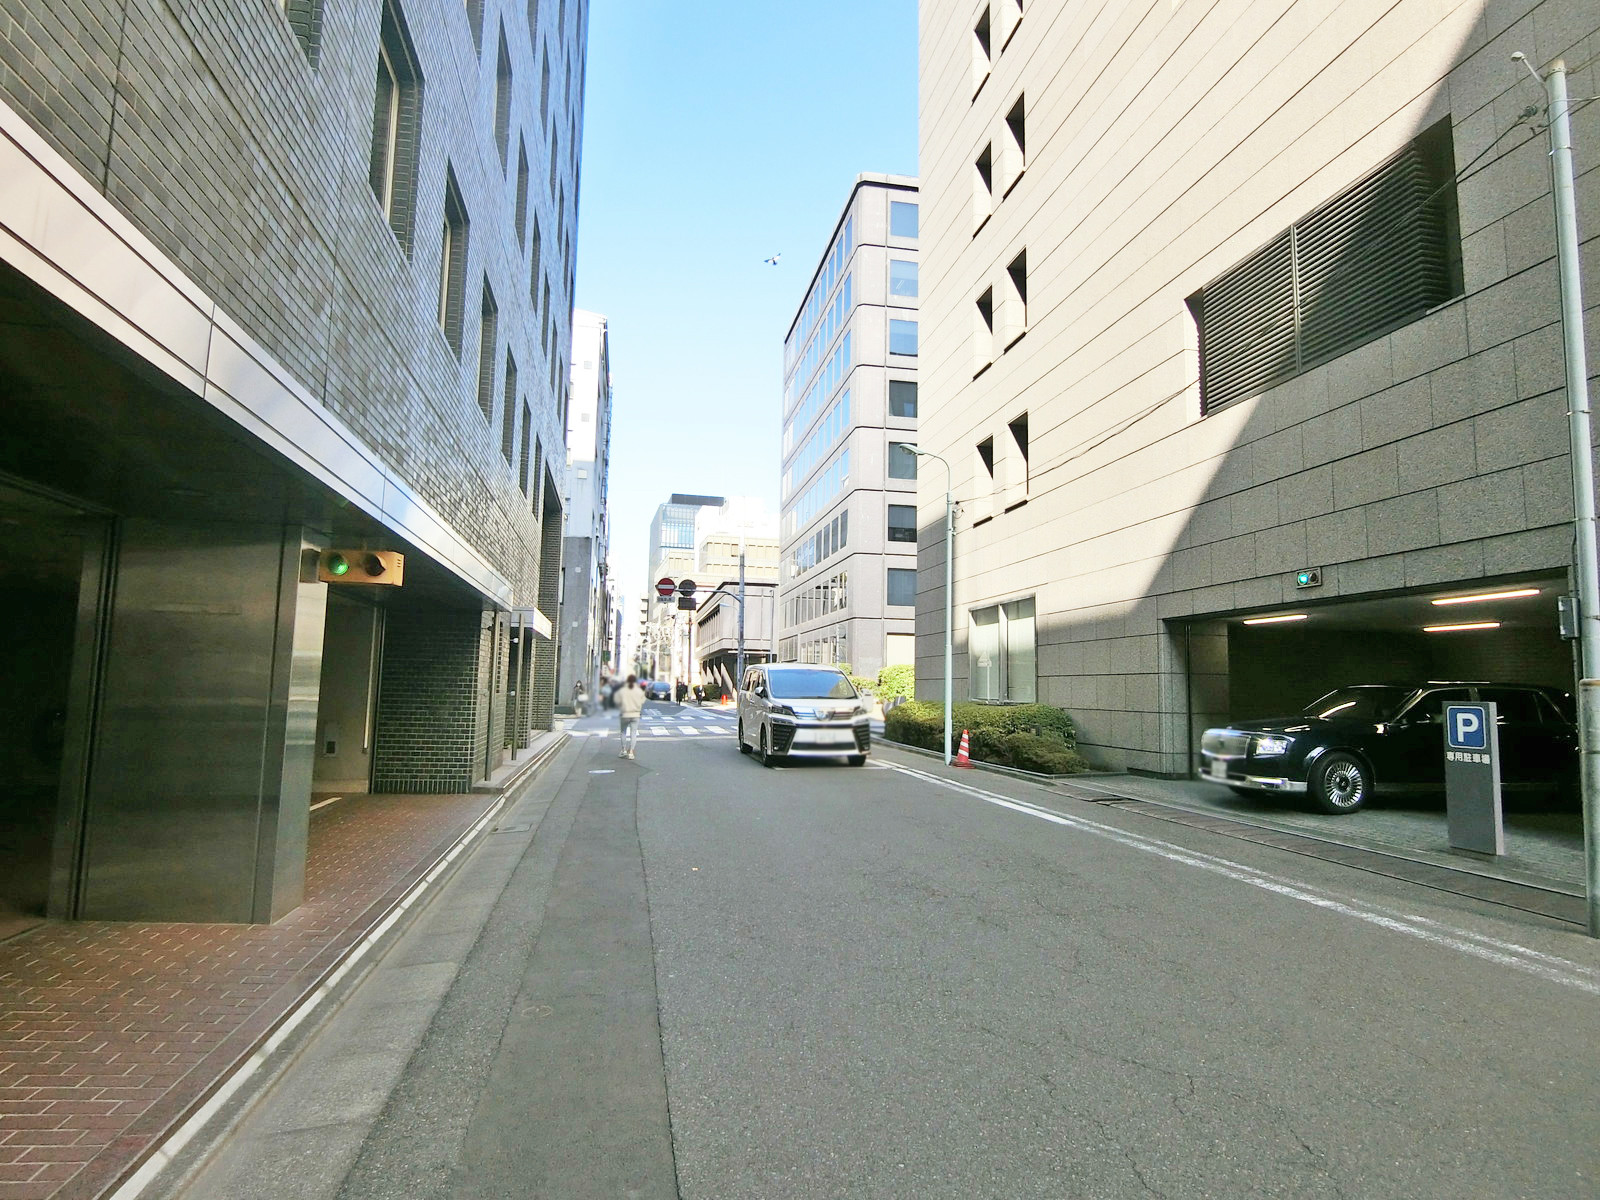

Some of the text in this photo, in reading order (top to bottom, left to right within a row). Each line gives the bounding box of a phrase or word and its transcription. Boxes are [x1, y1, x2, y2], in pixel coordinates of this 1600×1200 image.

[1456, 712, 1479, 743] P
[1446, 751, 1491, 765] 専用駐車場
